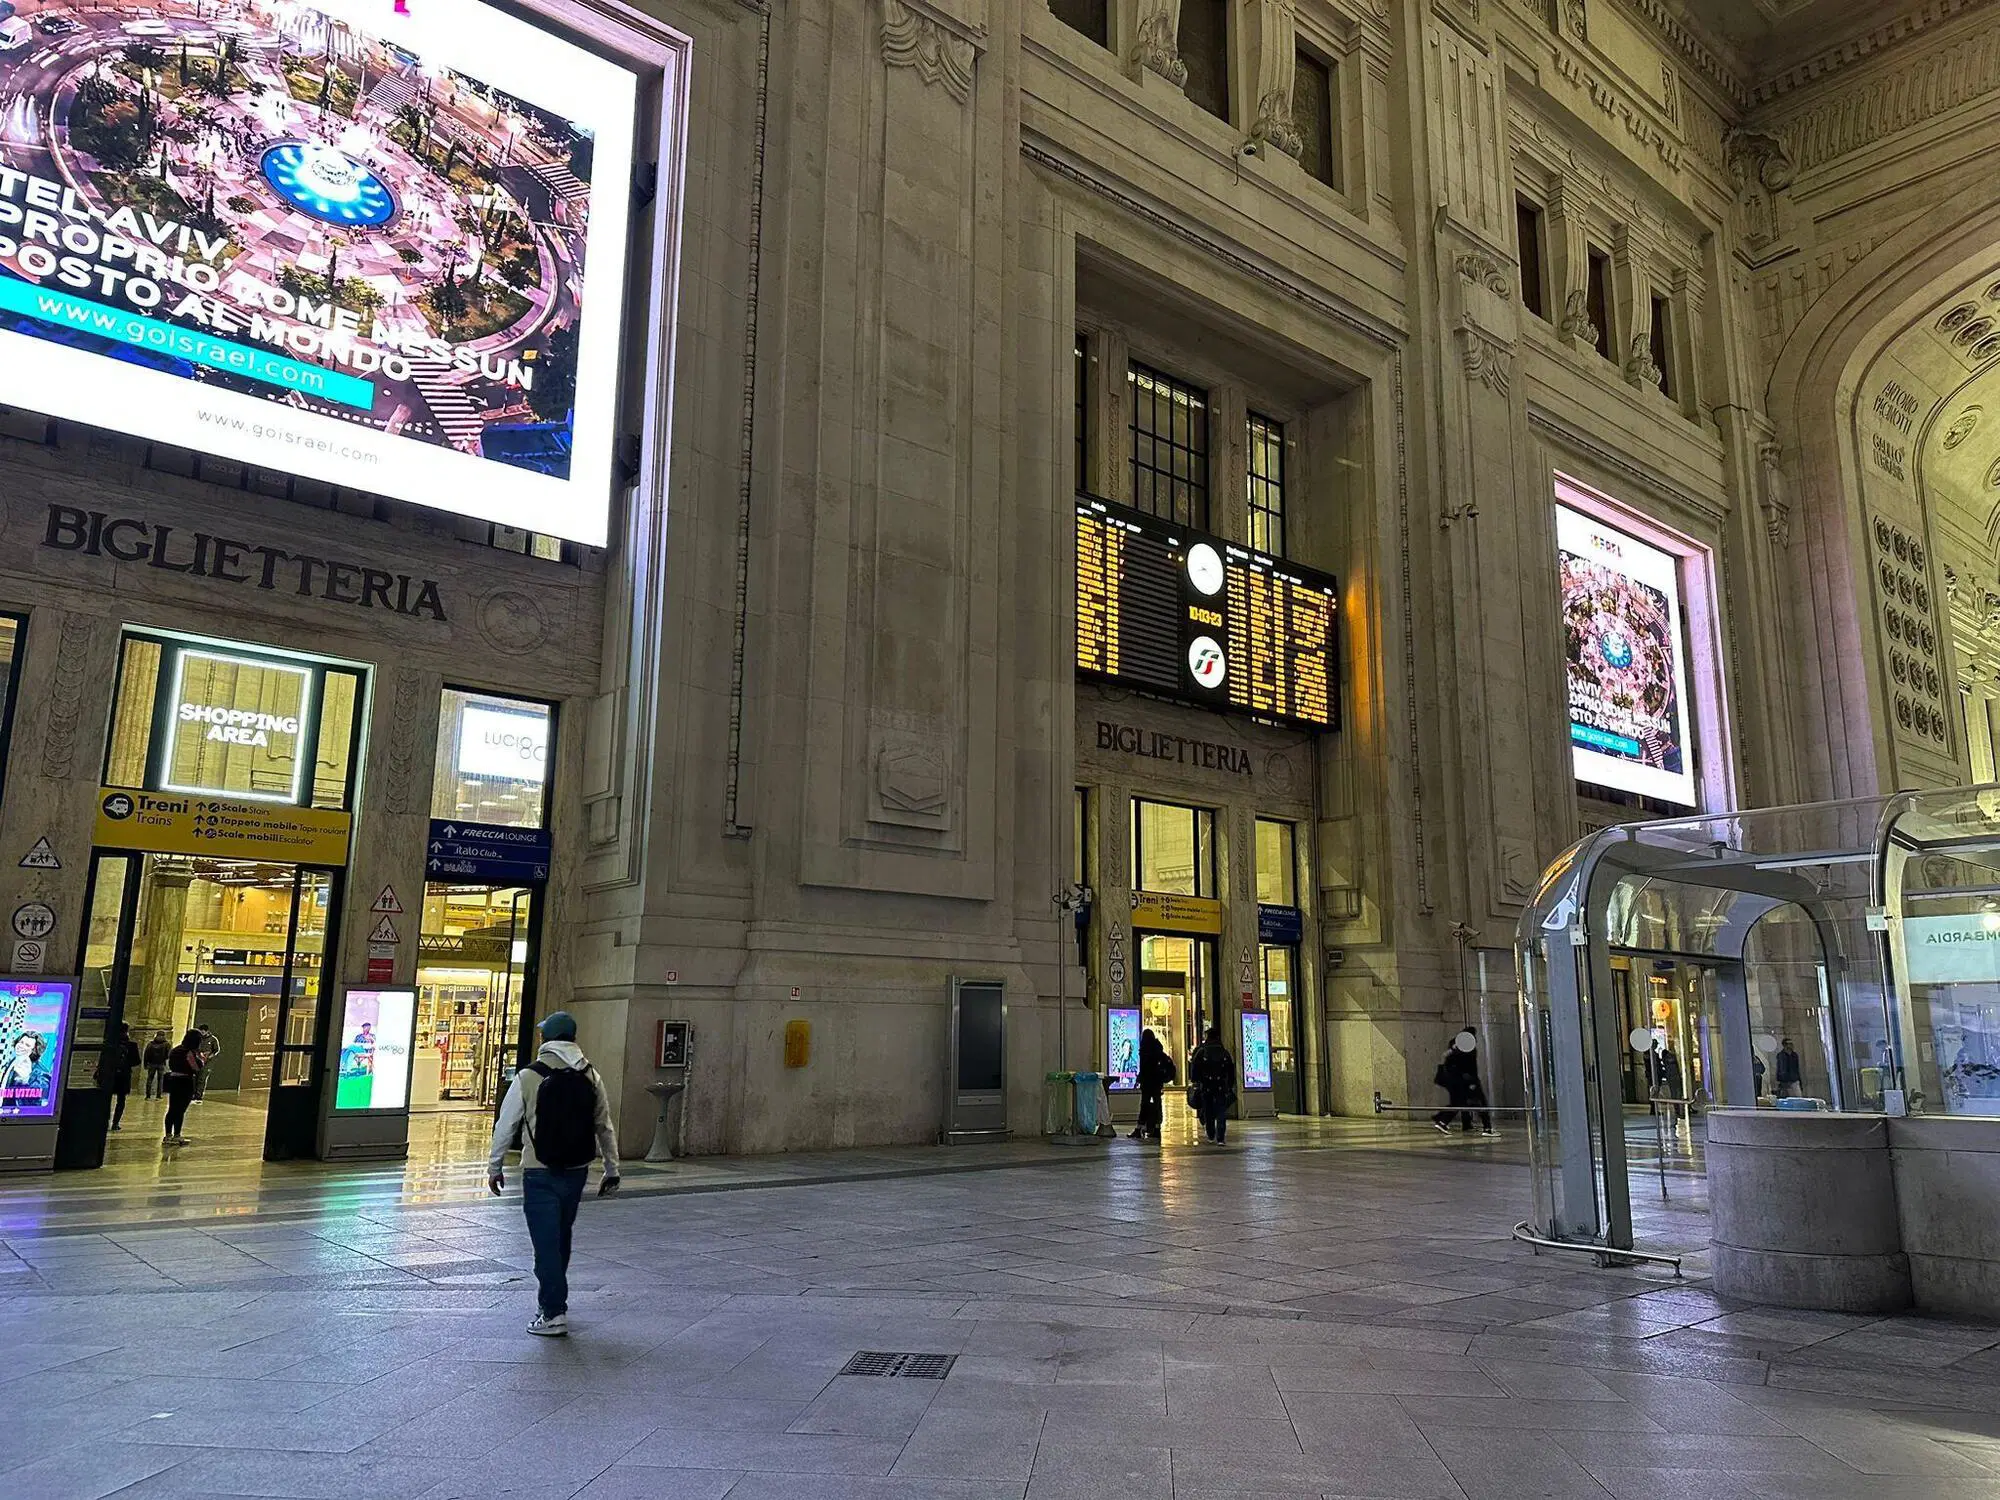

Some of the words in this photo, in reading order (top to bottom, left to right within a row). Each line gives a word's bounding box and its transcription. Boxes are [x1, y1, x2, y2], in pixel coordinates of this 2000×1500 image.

[250, 313, 411, 381] MONDO
[40, 502, 448, 621] BIGLIETTERIA
[180, 703, 299, 734] SHOPPING
[207, 725, 268, 747] AREA
[1096, 721, 1253, 776] BIGLIETTERIA
[138, 796, 188, 813] Treni
[221, 803, 248, 814] Scale
[249, 805, 271, 816] Stairs
[136, 811, 172, 826] Trains
[220, 816, 260, 828] Tappeto
[263, 821, 298, 831] mobile
[218, 828, 244, 839] Scale
[247, 832, 278, 842] mobili
[279, 834, 315, 846] Escalator
[198, 974, 252, 986] Ascensore
[253, 976, 266, 986] Lift
